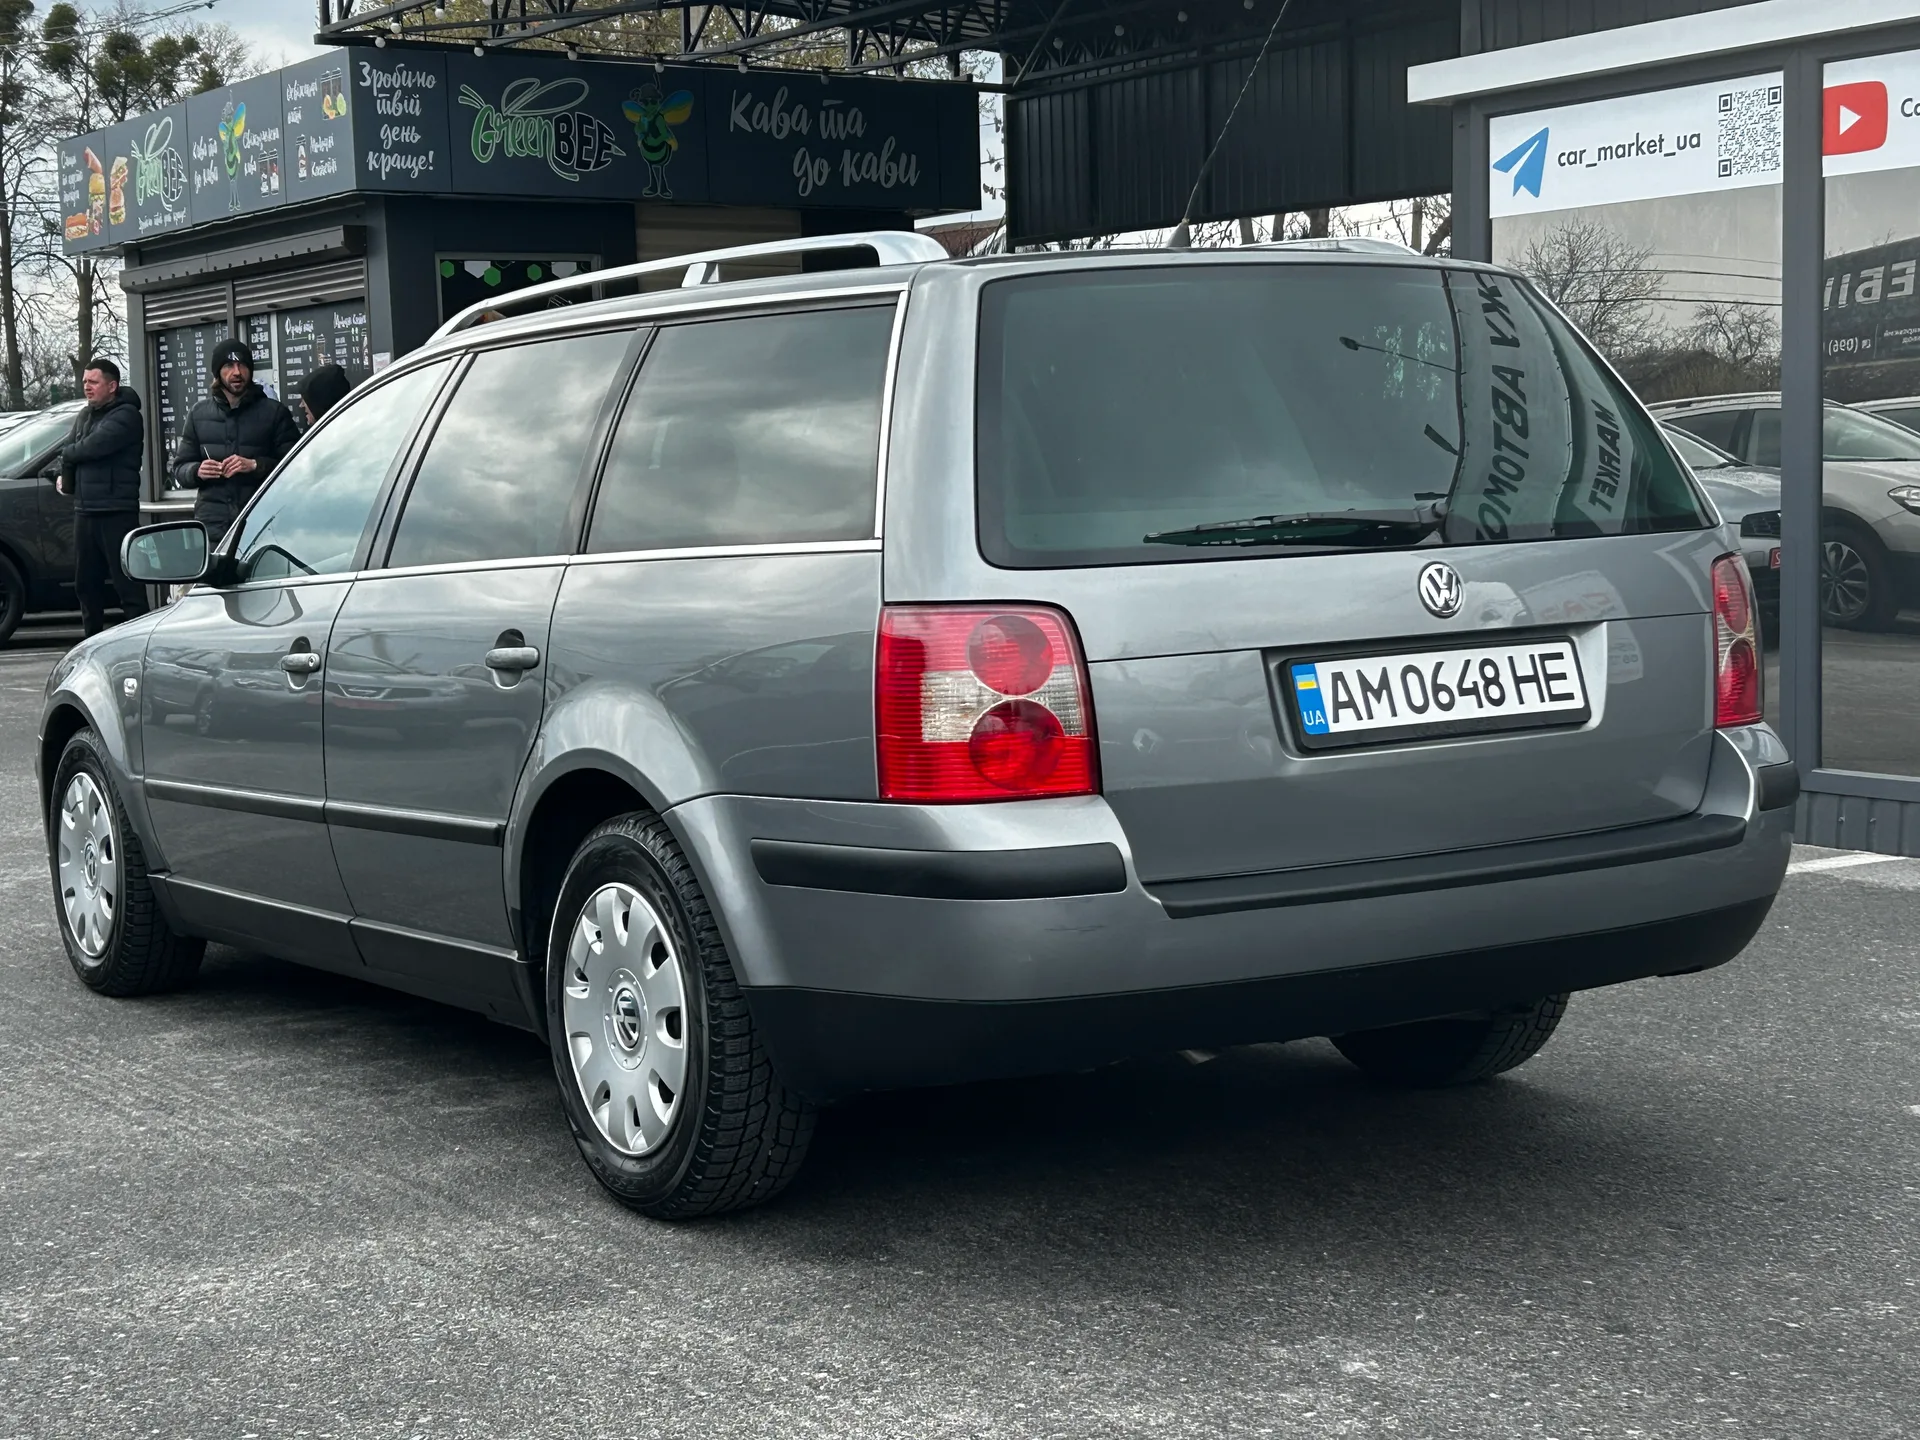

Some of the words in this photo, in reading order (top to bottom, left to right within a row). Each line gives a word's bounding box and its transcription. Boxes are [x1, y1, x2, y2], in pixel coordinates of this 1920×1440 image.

[359, 61, 437, 96] Зробимо
[376, 89, 422, 117] твій
[729, 86, 812, 140] Кава
[819, 99, 867, 140] та
[380, 123, 421, 150] день
[1557, 131, 1701, 168] car_market_ua
[366, 150, 434, 181] краще!
[793, 146, 831, 197] до
[839, 135, 921, 188] кави
[1303, 709, 1326, 727] UA
